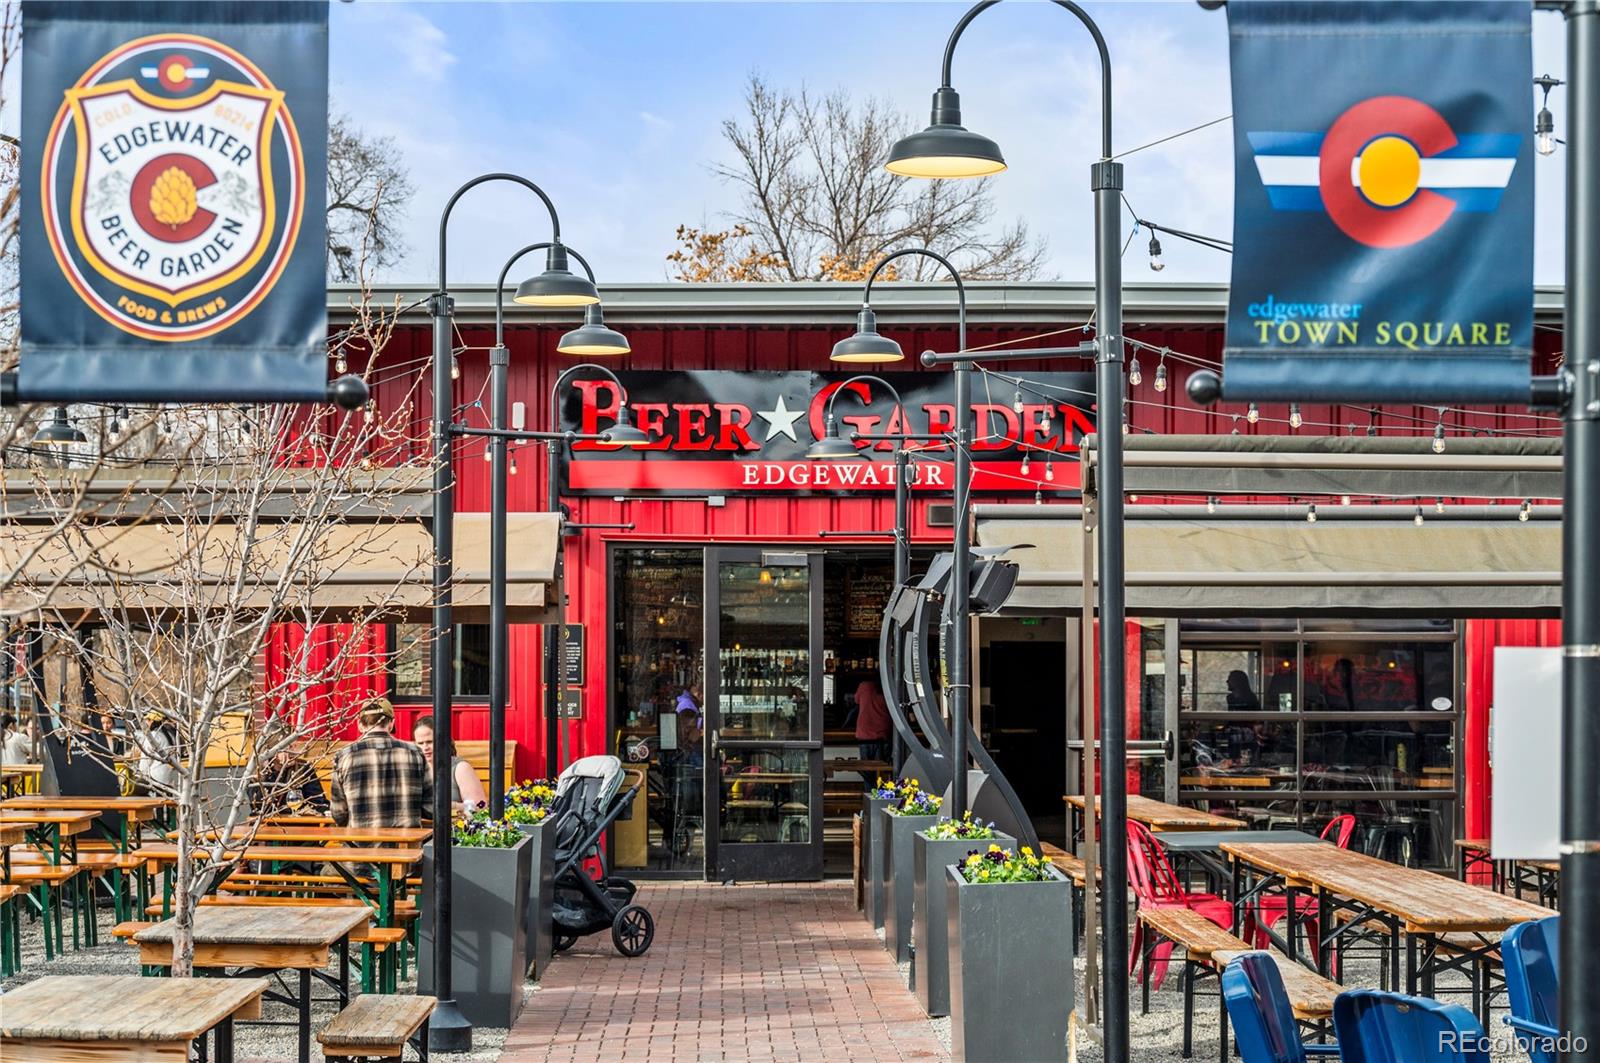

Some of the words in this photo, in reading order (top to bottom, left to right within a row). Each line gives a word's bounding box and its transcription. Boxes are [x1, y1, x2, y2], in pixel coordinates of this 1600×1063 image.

[214, 103, 254, 131] 80214
[99, 120, 252, 166] EDGEWATER
[101, 215, 150, 270] BEER
[160, 217, 243, 277] GARDEN
[117, 295, 157, 321] FOOD
[160, 311, 172, 323] &
[177, 296, 227, 324] BREWS
[1248, 294, 1362, 324] edgewater
[1254, 320, 1360, 344] TOWN
[1375, 321, 1512, 350] SQUARE
[571, 379, 761, 451] BEER
[808, 380, 1097, 453] GARDEN
